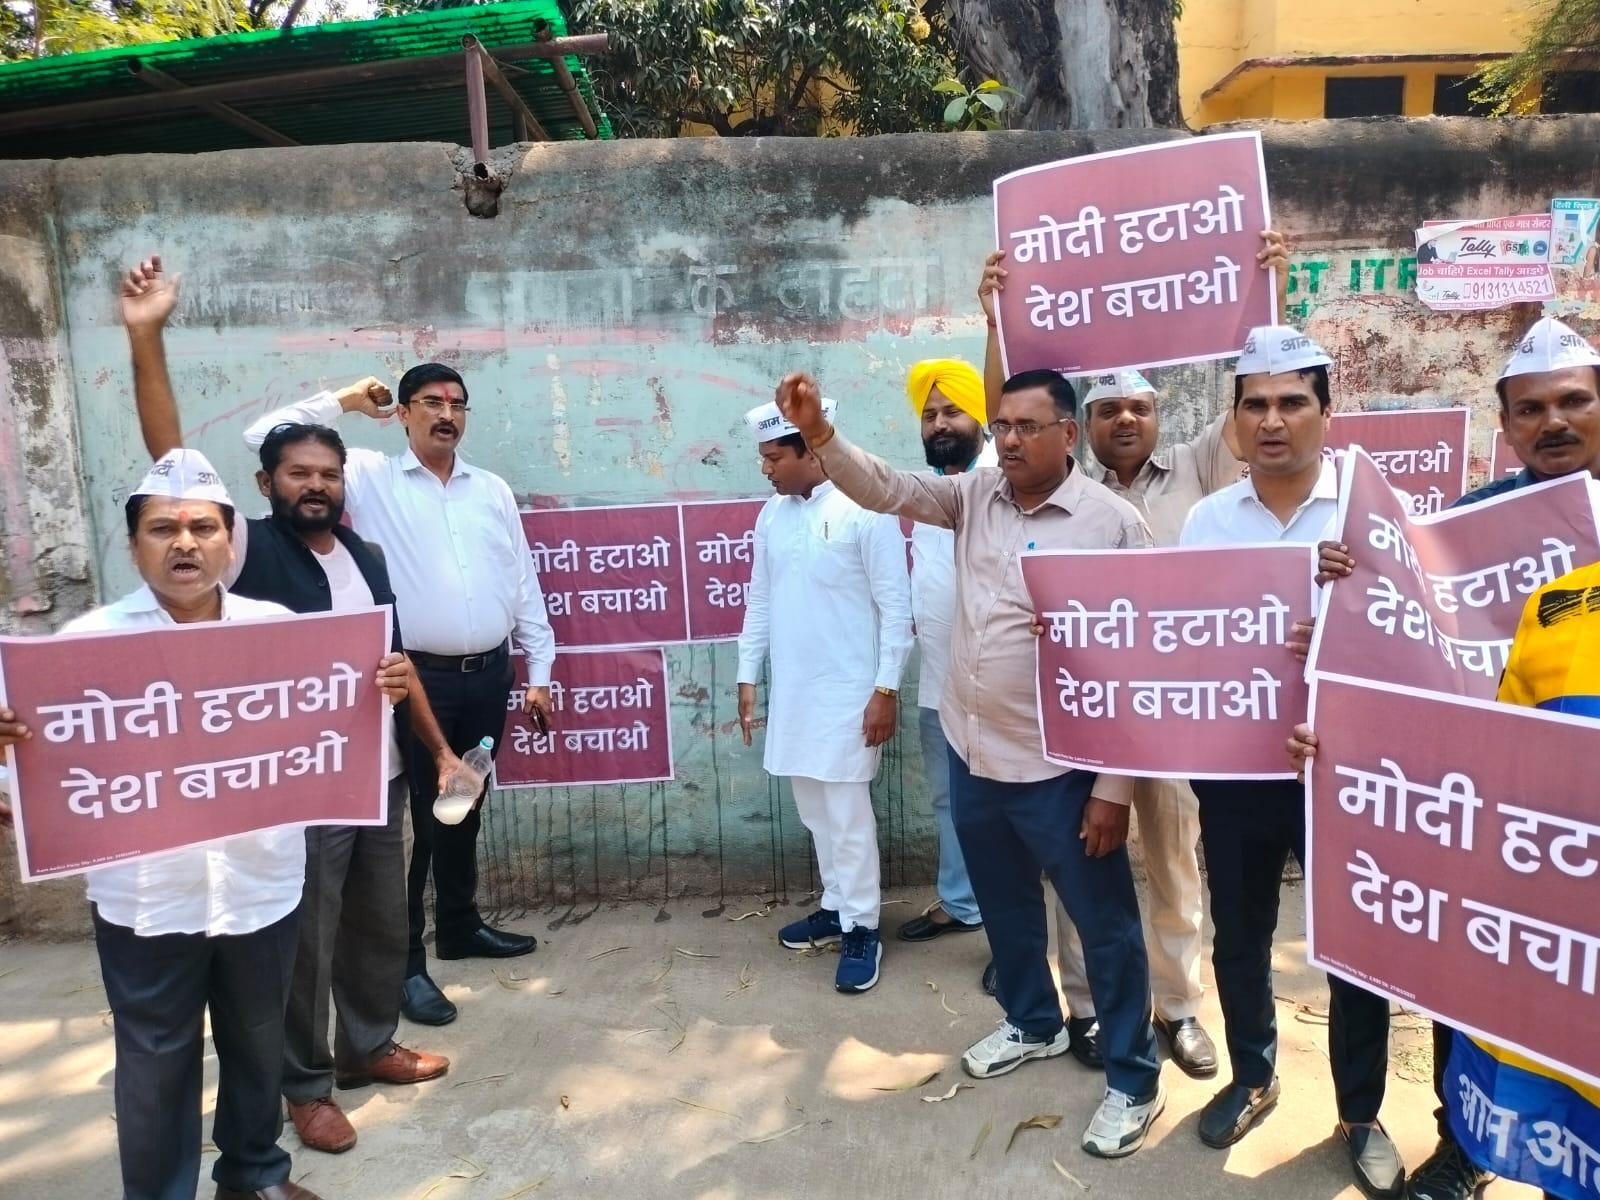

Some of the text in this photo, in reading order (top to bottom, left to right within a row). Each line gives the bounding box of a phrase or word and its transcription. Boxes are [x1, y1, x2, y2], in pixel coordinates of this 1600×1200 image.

[1009, 184, 1246, 264] मोदी हटाओ
[1458, 236, 1497, 259] Tally
[1024, 255, 1241, 331] देश बचाओ
[1418, 266, 1434, 276] Job
[1466, 266, 1492, 276] Excel
[1493, 266, 1515, 278] Tally
[758, 416, 780, 430] आम
[586, 536, 670, 573] हटाओ
[1424, 537, 1577, 615] हटाओ
[578, 580, 667, 617] बचाओ
[1042, 593, 1290, 653] मोदी हटाओ
[1366, 575, 1435, 647] देश
[36, 662, 363, 744] मोदी हटाओ
[571, 678, 653, 713] हटाओ
[1055, 667, 1282, 720] देश बचाओ
[511, 721, 649, 755] देश बचाओ
[60, 730, 349, 819] देश बचाओ
[1335, 758, 1484, 851] मोदी
[1346, 849, 1449, 942] देश
